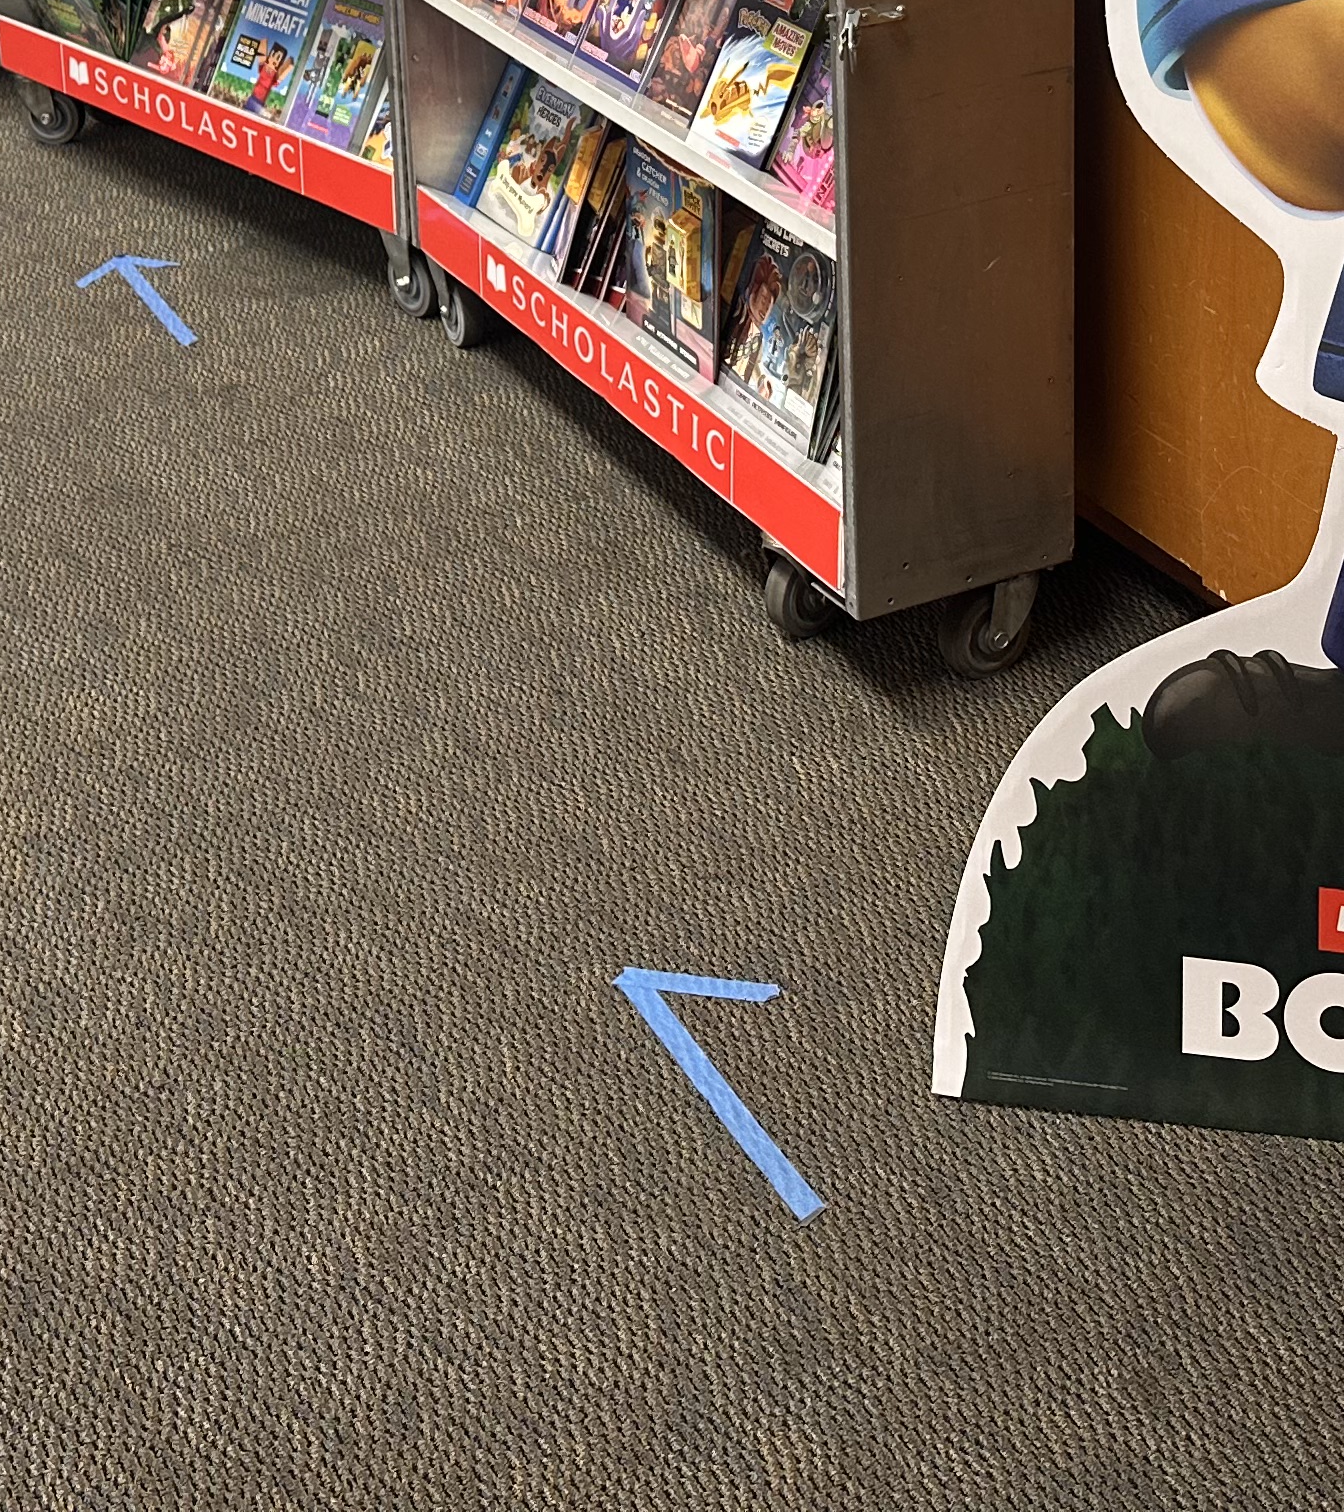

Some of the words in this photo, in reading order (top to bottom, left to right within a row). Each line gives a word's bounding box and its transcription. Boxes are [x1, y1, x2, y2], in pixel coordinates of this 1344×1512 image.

[245, 0, 305, 37] MINECRAFT
[773, 21, 804, 46] AMAZING
[772, 38, 796, 56] MOVES
[536, 87, 576, 118] EVERYDAY
[538, 106, 561, 127] HEROES
[94, 68, 297, 174] SCHOLASTIC
[511, 275, 726, 470] SCHOLASTIC
